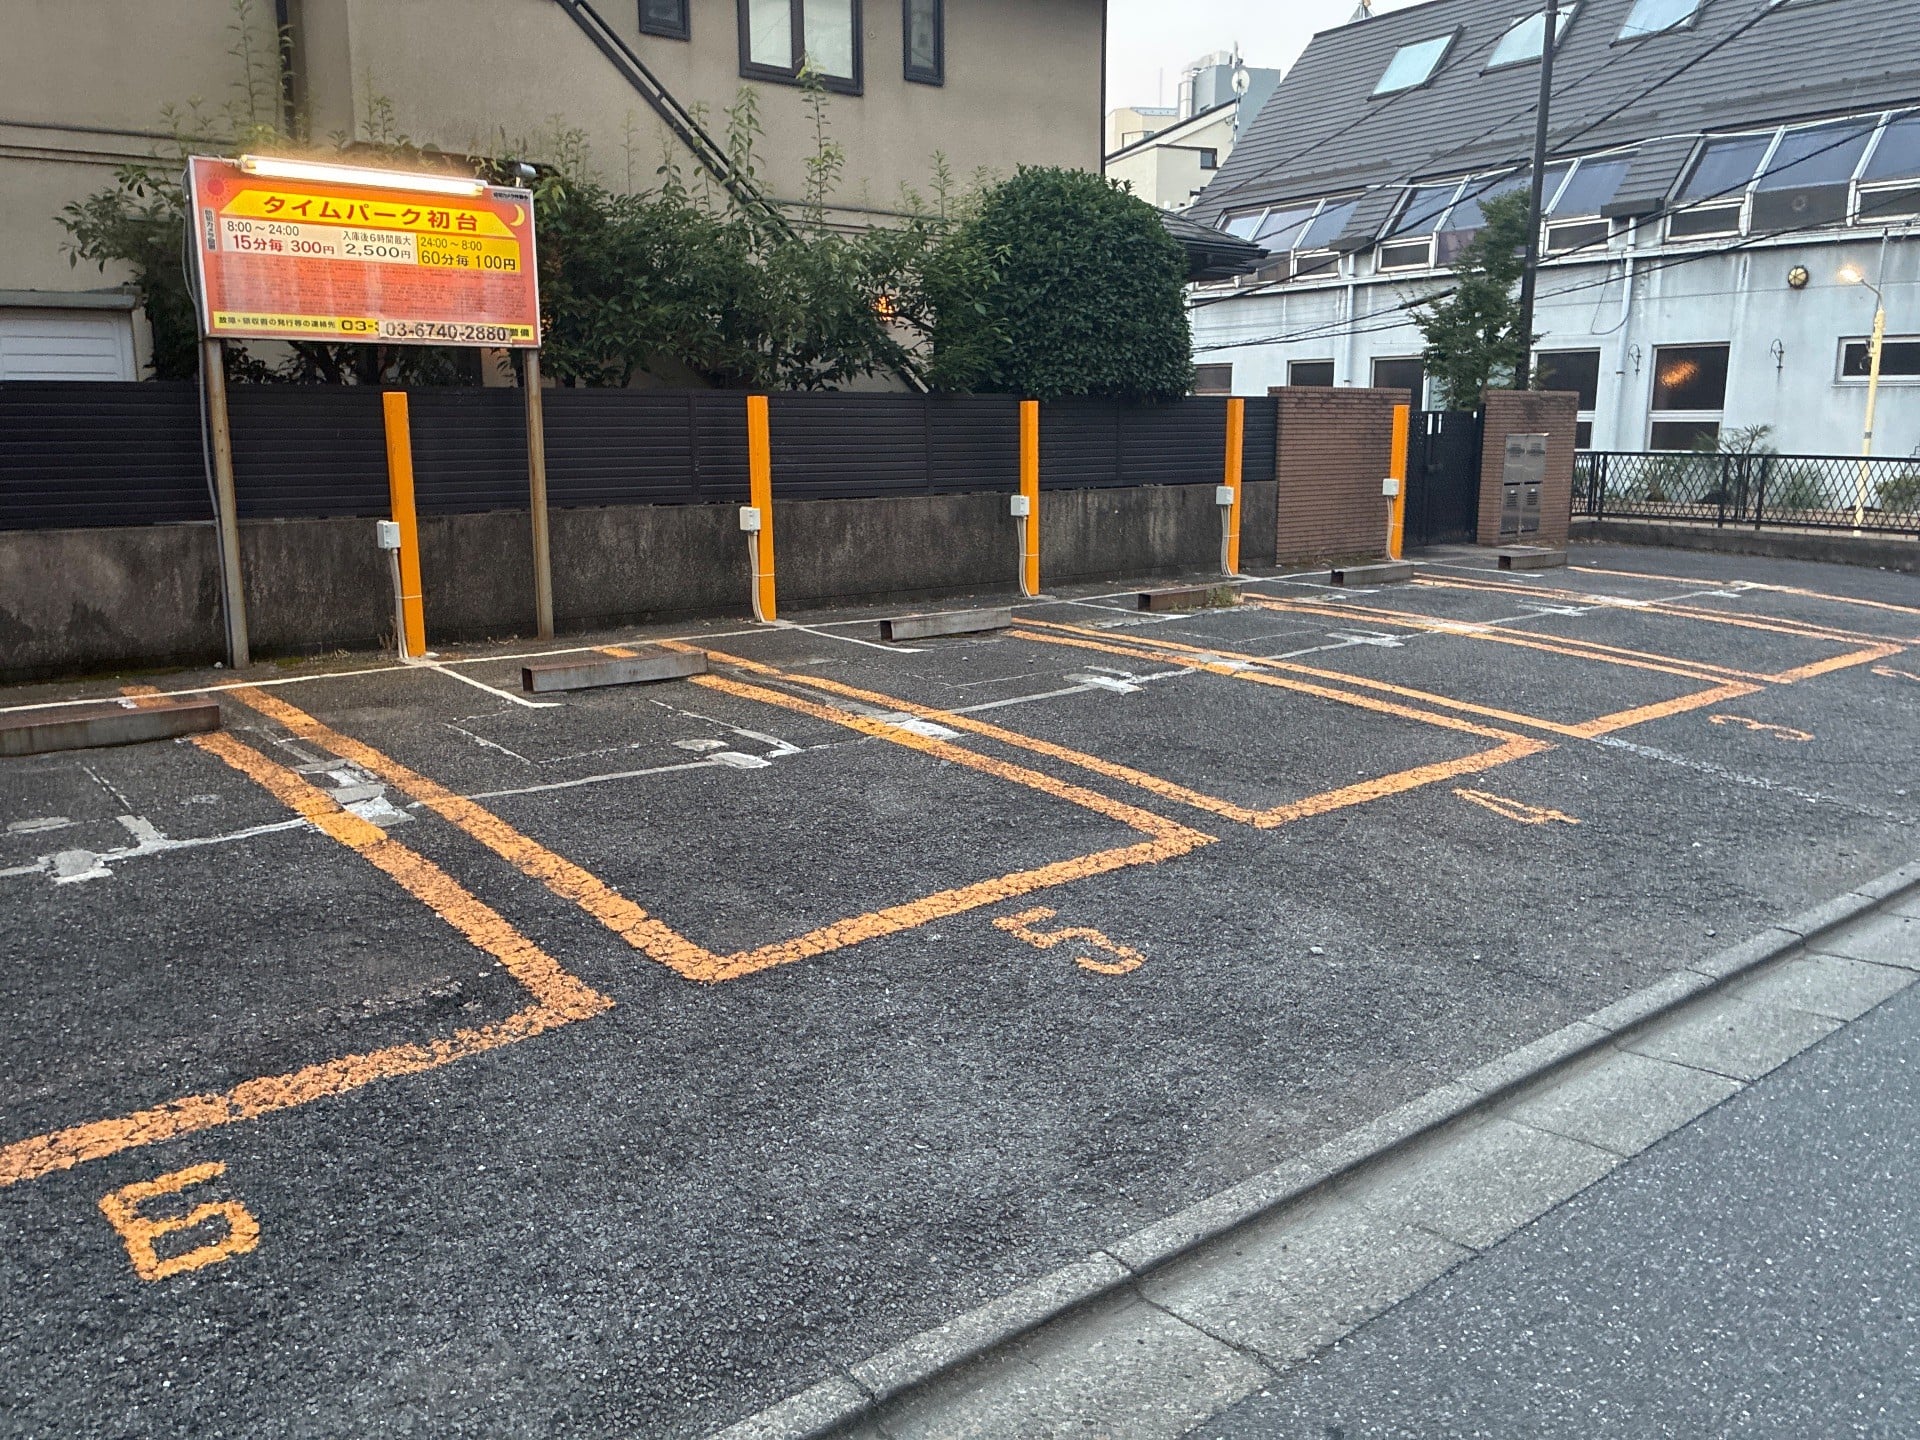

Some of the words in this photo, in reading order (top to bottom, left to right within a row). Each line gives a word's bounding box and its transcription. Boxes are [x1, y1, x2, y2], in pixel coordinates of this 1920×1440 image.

[264, 196, 478, 231] タイムパーク初台
[343, 230, 411, 246] 入庫後6時間最大
[345, 243, 411, 260] 2,500円
[385, 322, 507, 342] 03-6740-2880
[1708, 714, 1815, 742] 3
[992, 906, 1147, 975] 5
[98, 1160, 260, 1281] 6
